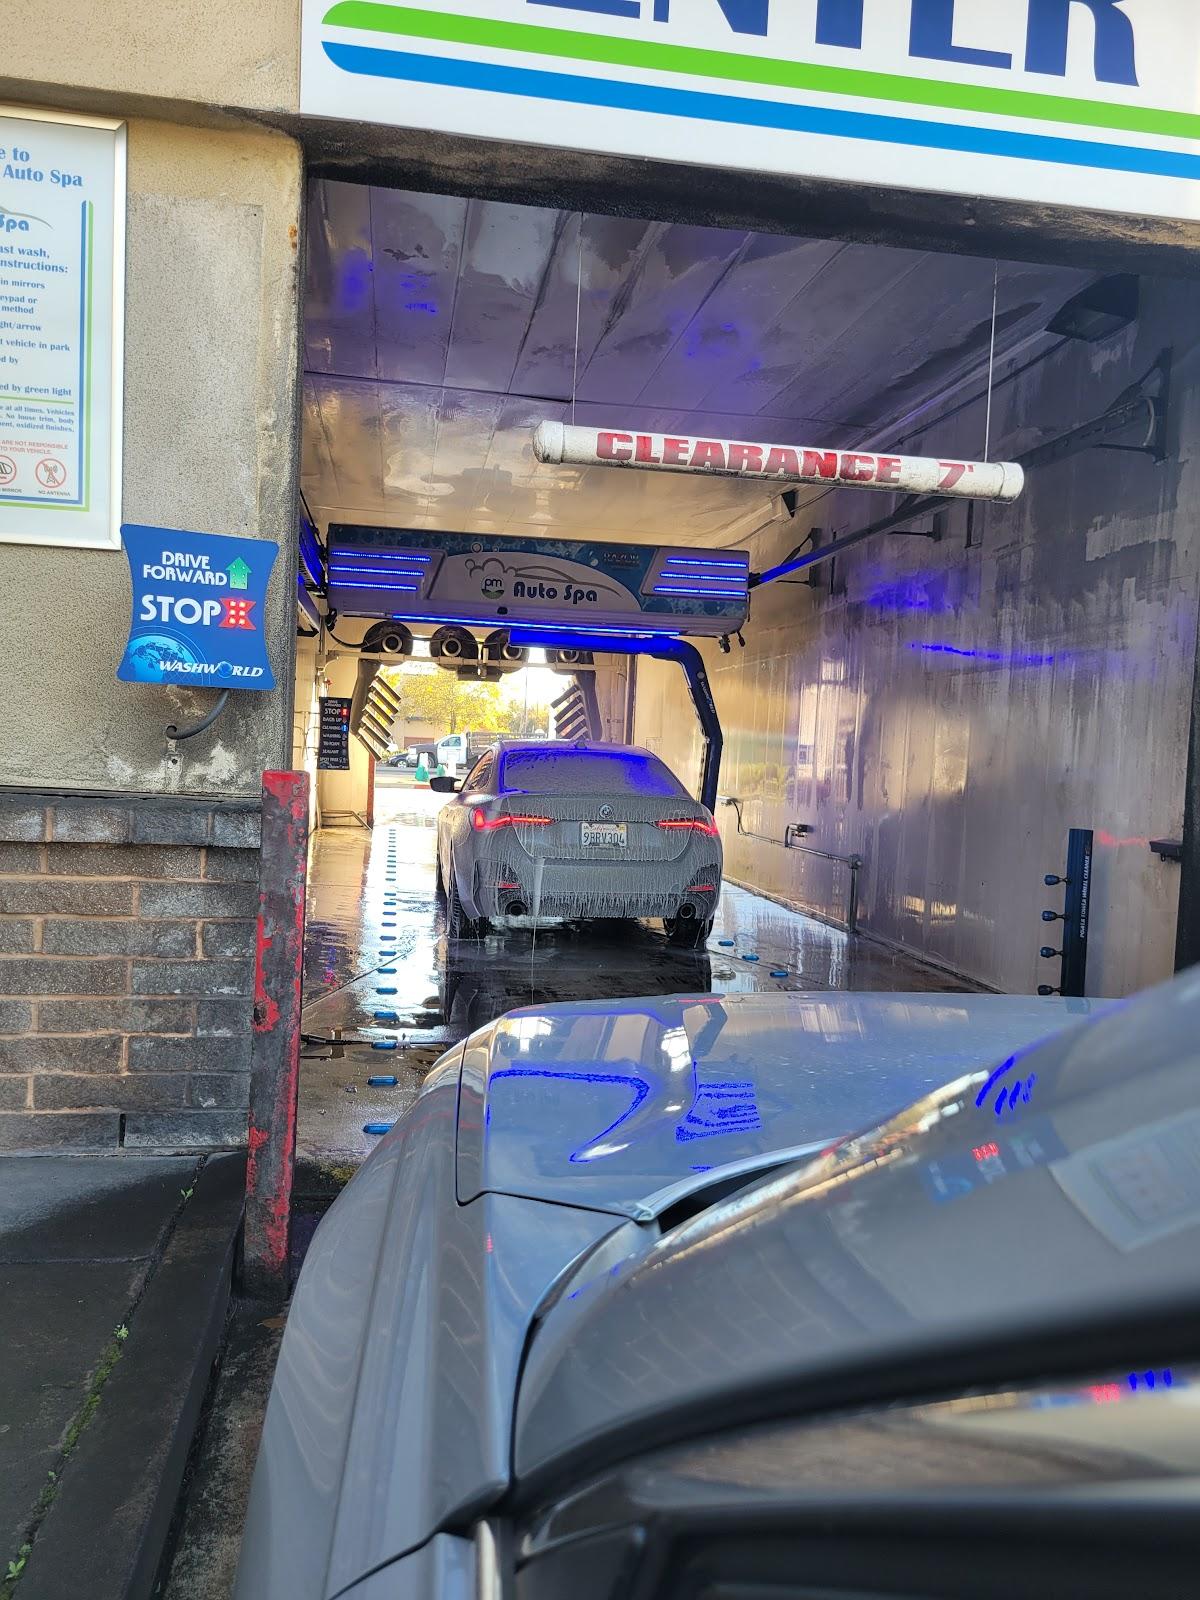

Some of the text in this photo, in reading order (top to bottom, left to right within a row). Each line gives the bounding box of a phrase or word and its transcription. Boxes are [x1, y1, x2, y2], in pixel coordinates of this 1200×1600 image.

[13, 147, 30, 162] to
[3, 164, 83, 188] Auto Spa
[18, 248, 50, 258] wash,
[0, 259, 68, 273] nstructions:
[12, 280, 46, 289] mirrors
[0, 295, 25, 304] eypad
[2, 305, 34, 314] method
[0, 321, 41, 331] ght/arrow
[6, 339, 37, 348] vehicle
[39, 341, 47, 349] in
[50, 344, 70, 352] park
[9, 356, 18, 364] by
[12, 384, 21, 392] by
[24, 385, 49, 394] green
[52, 387, 72, 397] light
[596, 431, 974, 488] CLEARANCE 7'
[162, 551, 211, 570] DRIVE
[143, 564, 228, 586] FORWARD
[484, 577, 503, 591] pm
[513, 581, 598, 604] Auto Spa
[140, 594, 222, 626] STOP
